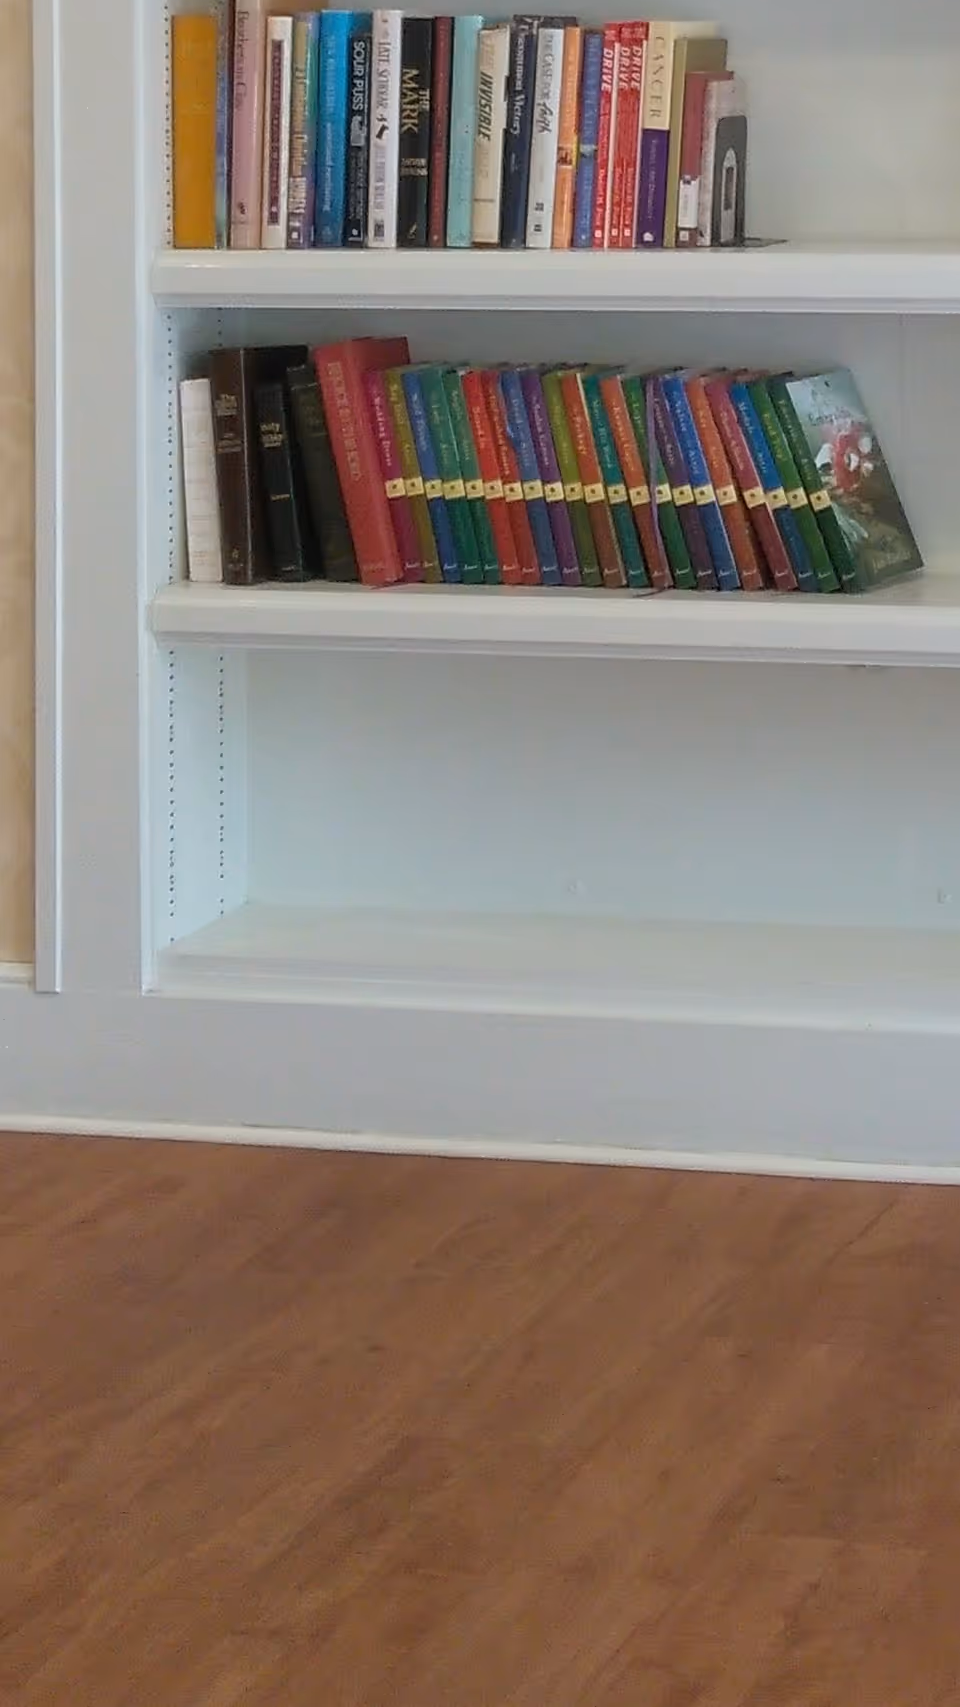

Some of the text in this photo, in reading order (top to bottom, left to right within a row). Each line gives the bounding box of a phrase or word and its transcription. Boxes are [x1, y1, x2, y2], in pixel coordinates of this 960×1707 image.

[352, 41, 365, 111] SOUR PUSS
[401, 68, 420, 135] MARK
[419, 88, 430, 112] THE
[477, 71, 494, 142] INVISIBLE
[648, 34, 666, 122] CANCER
[509, 93, 525, 136] Victory
